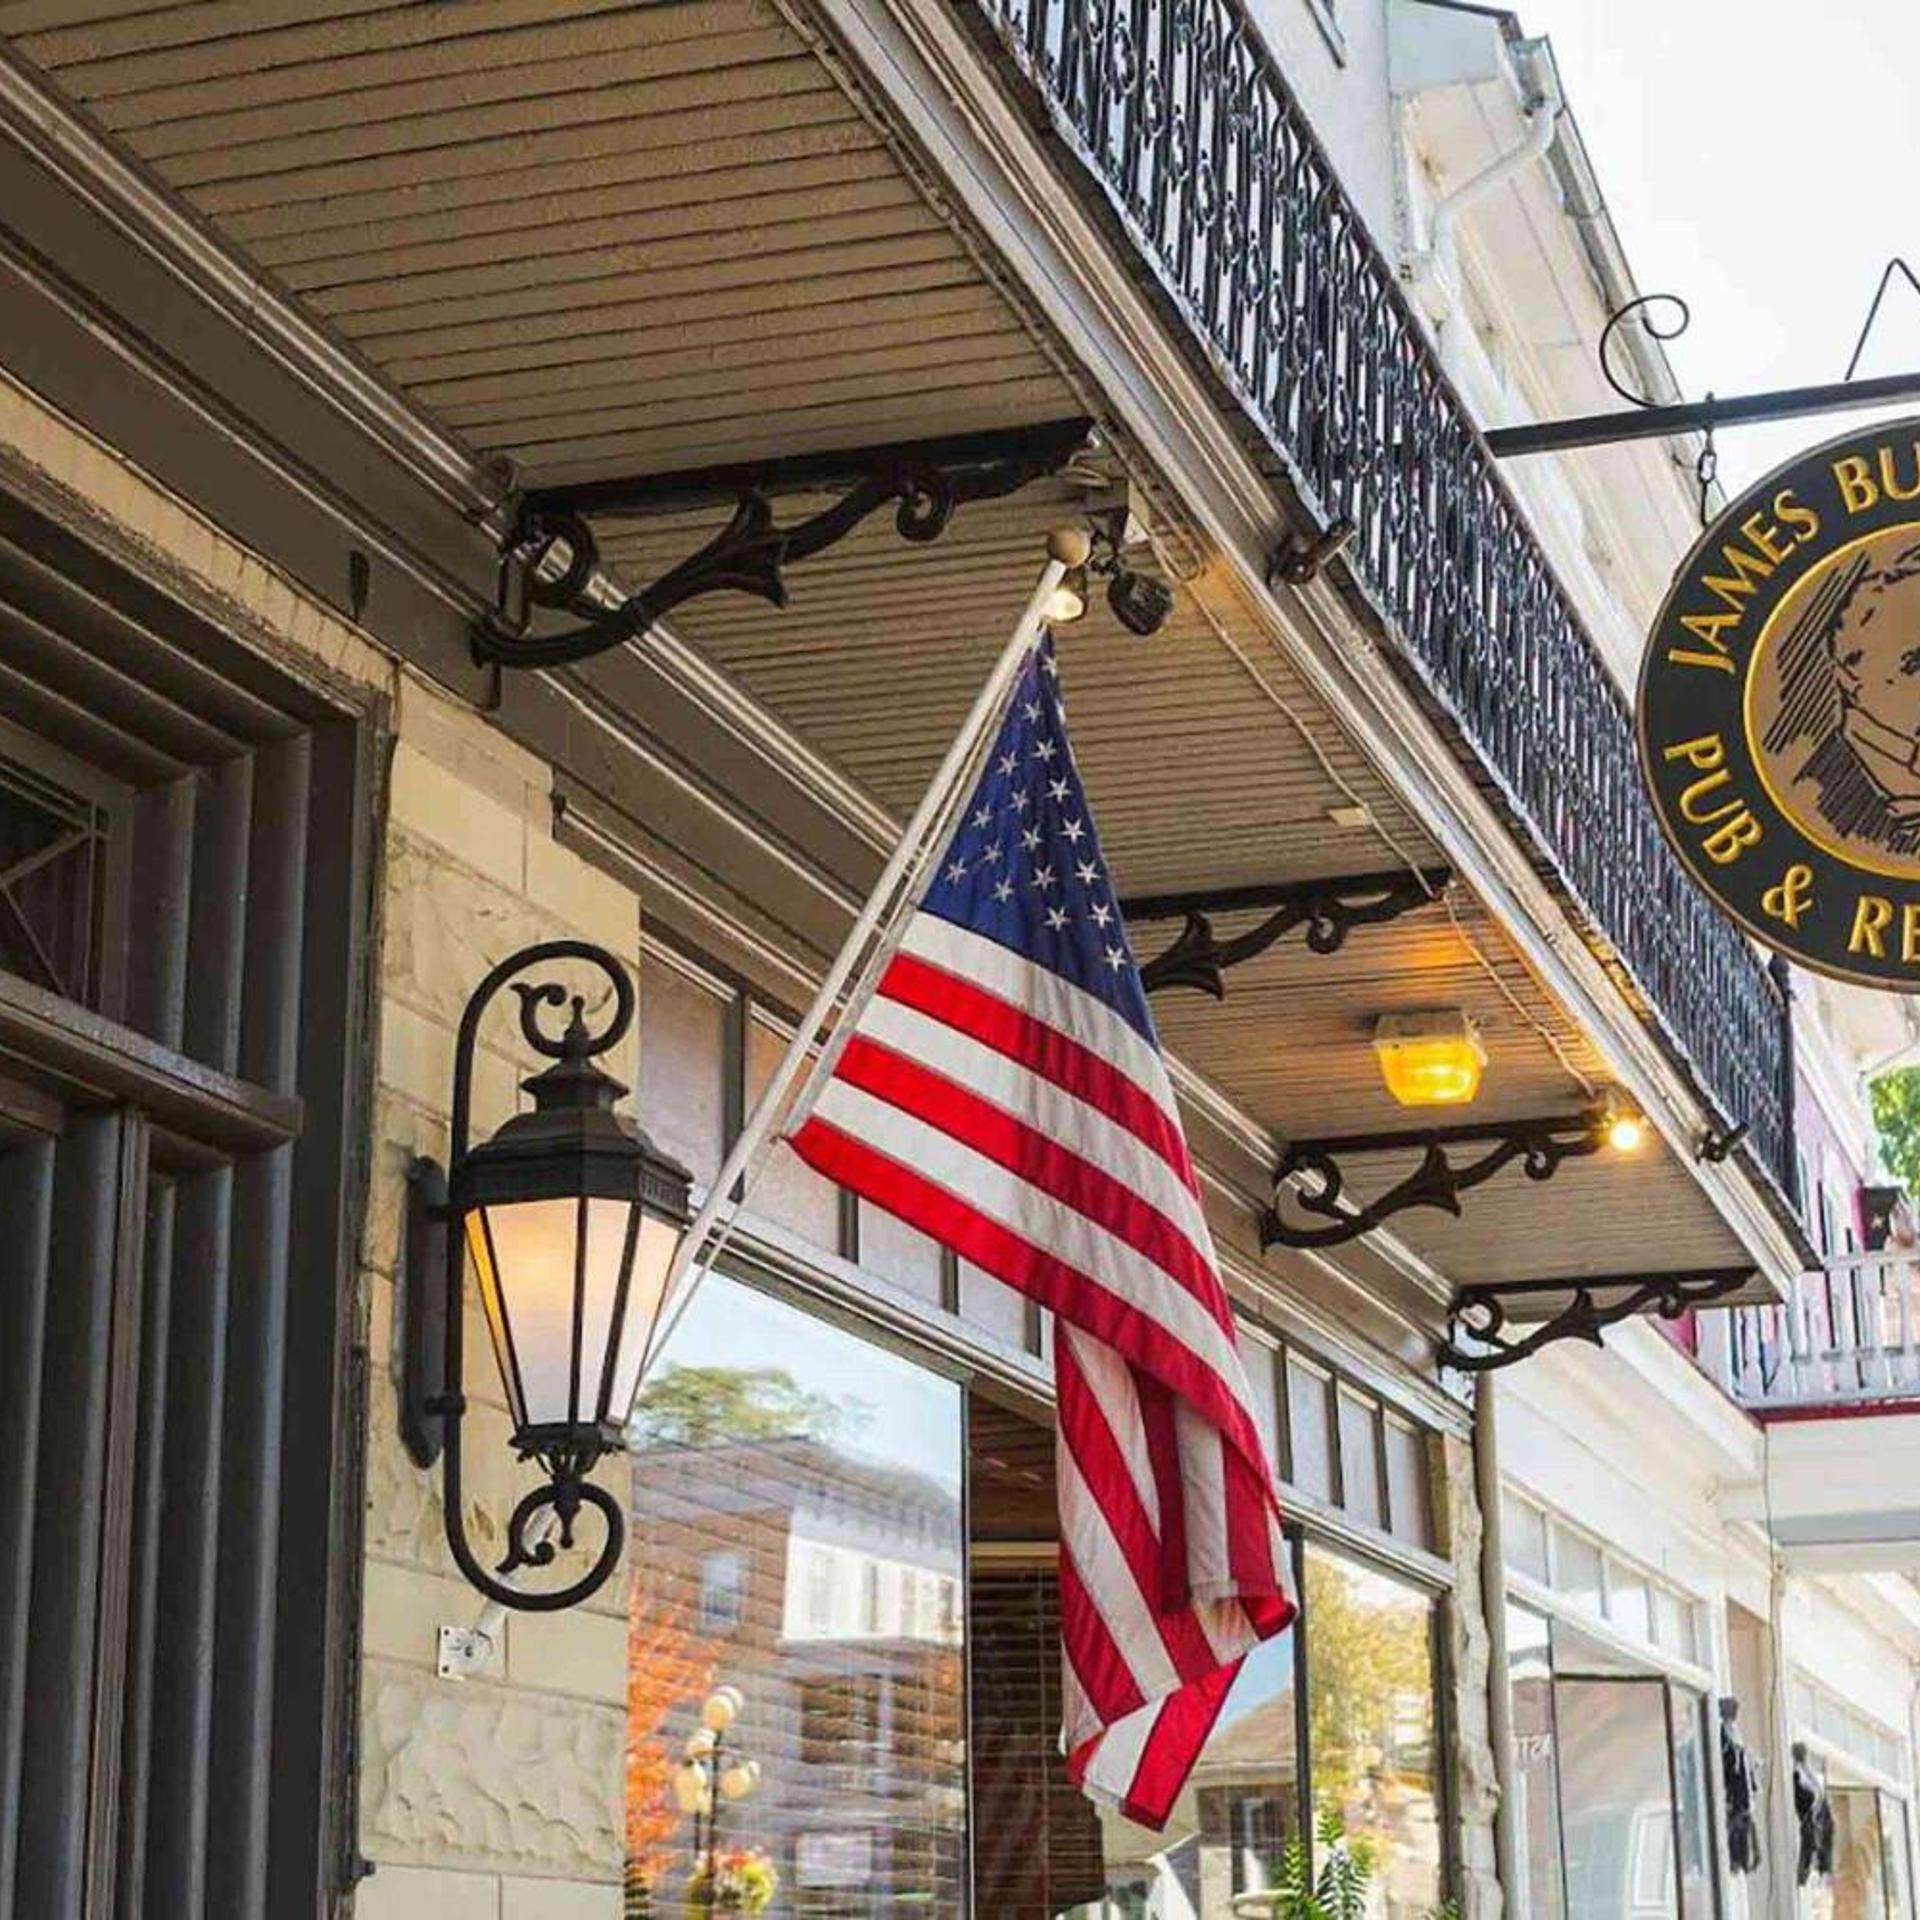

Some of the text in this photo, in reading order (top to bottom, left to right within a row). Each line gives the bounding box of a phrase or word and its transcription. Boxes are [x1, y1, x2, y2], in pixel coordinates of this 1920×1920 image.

[1668, 490, 1820, 674] JAMES
[1663, 733, 1764, 865] PUB
[1761, 865, 1813, 930] &
